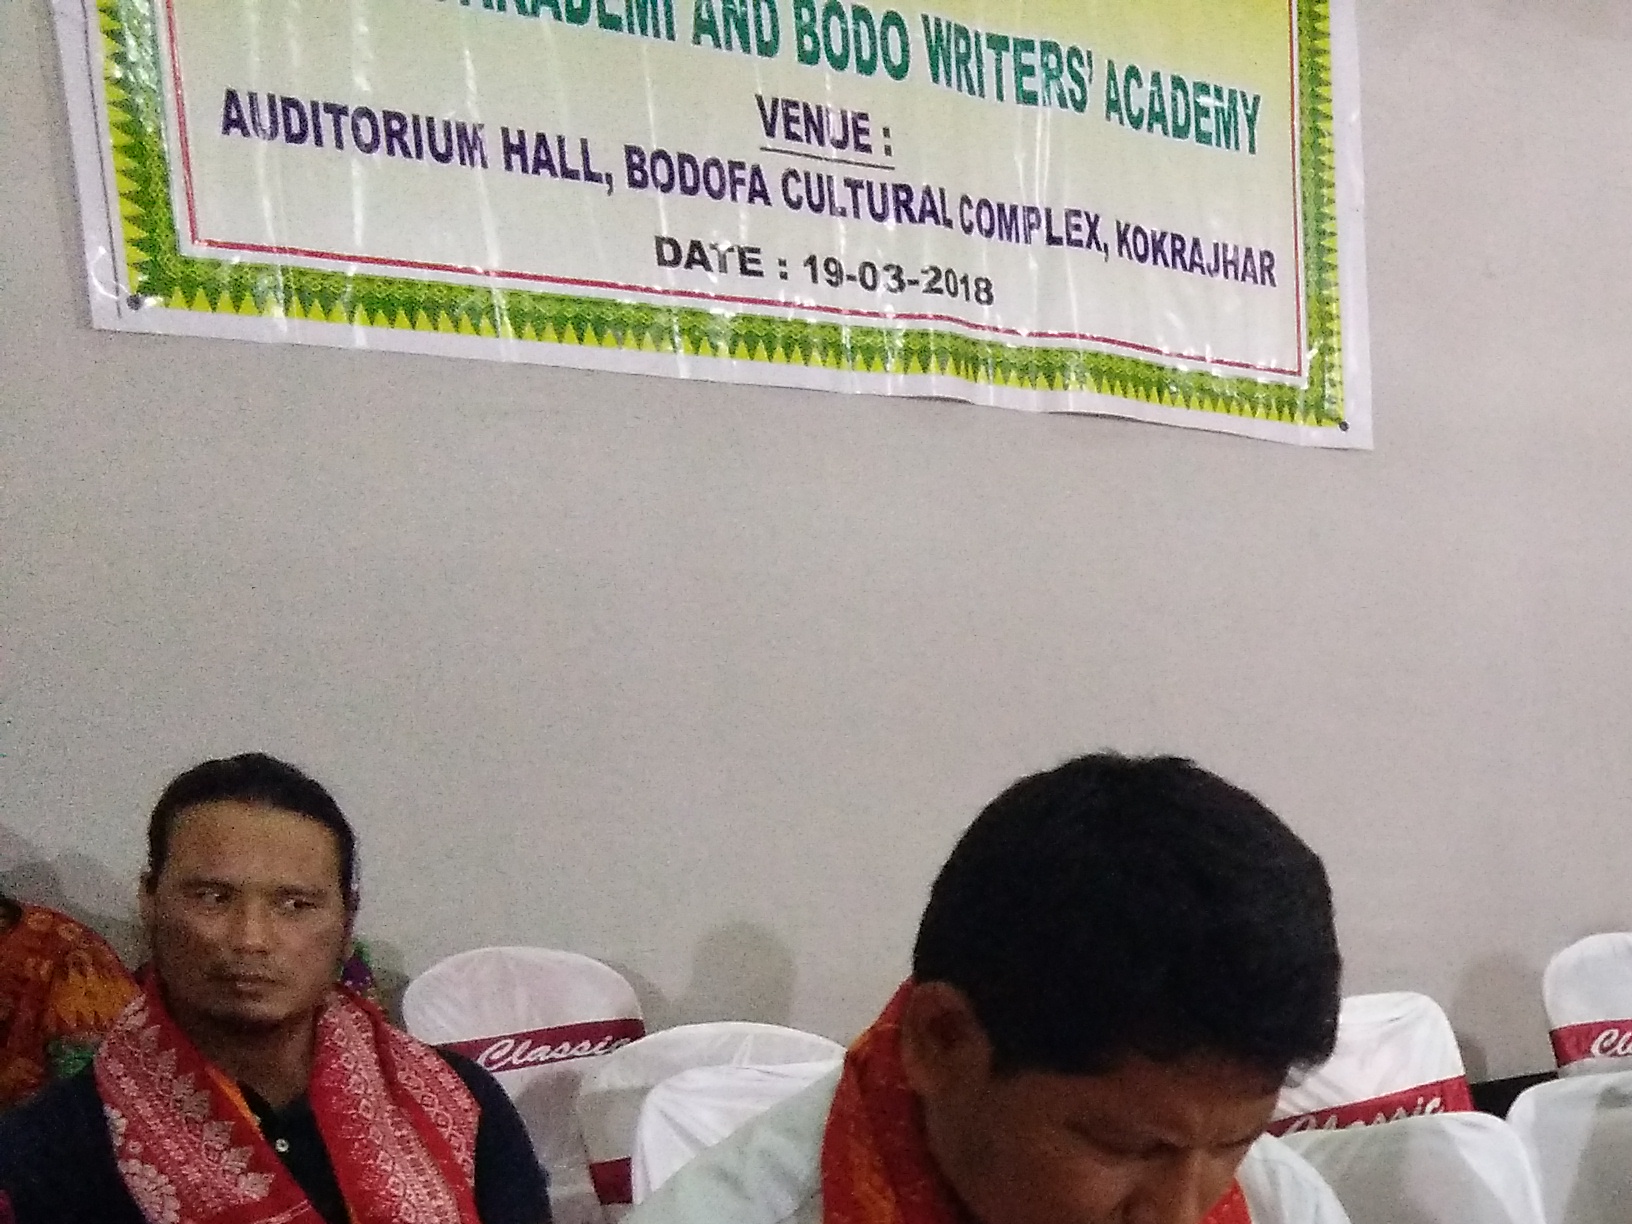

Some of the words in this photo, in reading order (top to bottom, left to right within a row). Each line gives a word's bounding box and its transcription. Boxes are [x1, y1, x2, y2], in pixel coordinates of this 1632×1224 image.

[691, 0, 781, 58] AND
[793, 0, 910, 82] BODO
[921, 14, 1094, 115] WRITERS'
[1104, 58, 1262, 156] ACADEMY
[756, 93, 873, 154] VENUE
[219, 87, 489, 170] AUDITORIUM
[501, 126, 614, 197] HALL,
[624, 143, 773, 207] BODOFA
[781, 166, 954, 230] CULTURAL
[958, 194, 1110, 263] COMPLEX,
[1115, 220, 1278, 288] KOKRAJHAR
[655, 234, 764, 278] DATE
[803, 252, 995, 307] 19-03-2018
